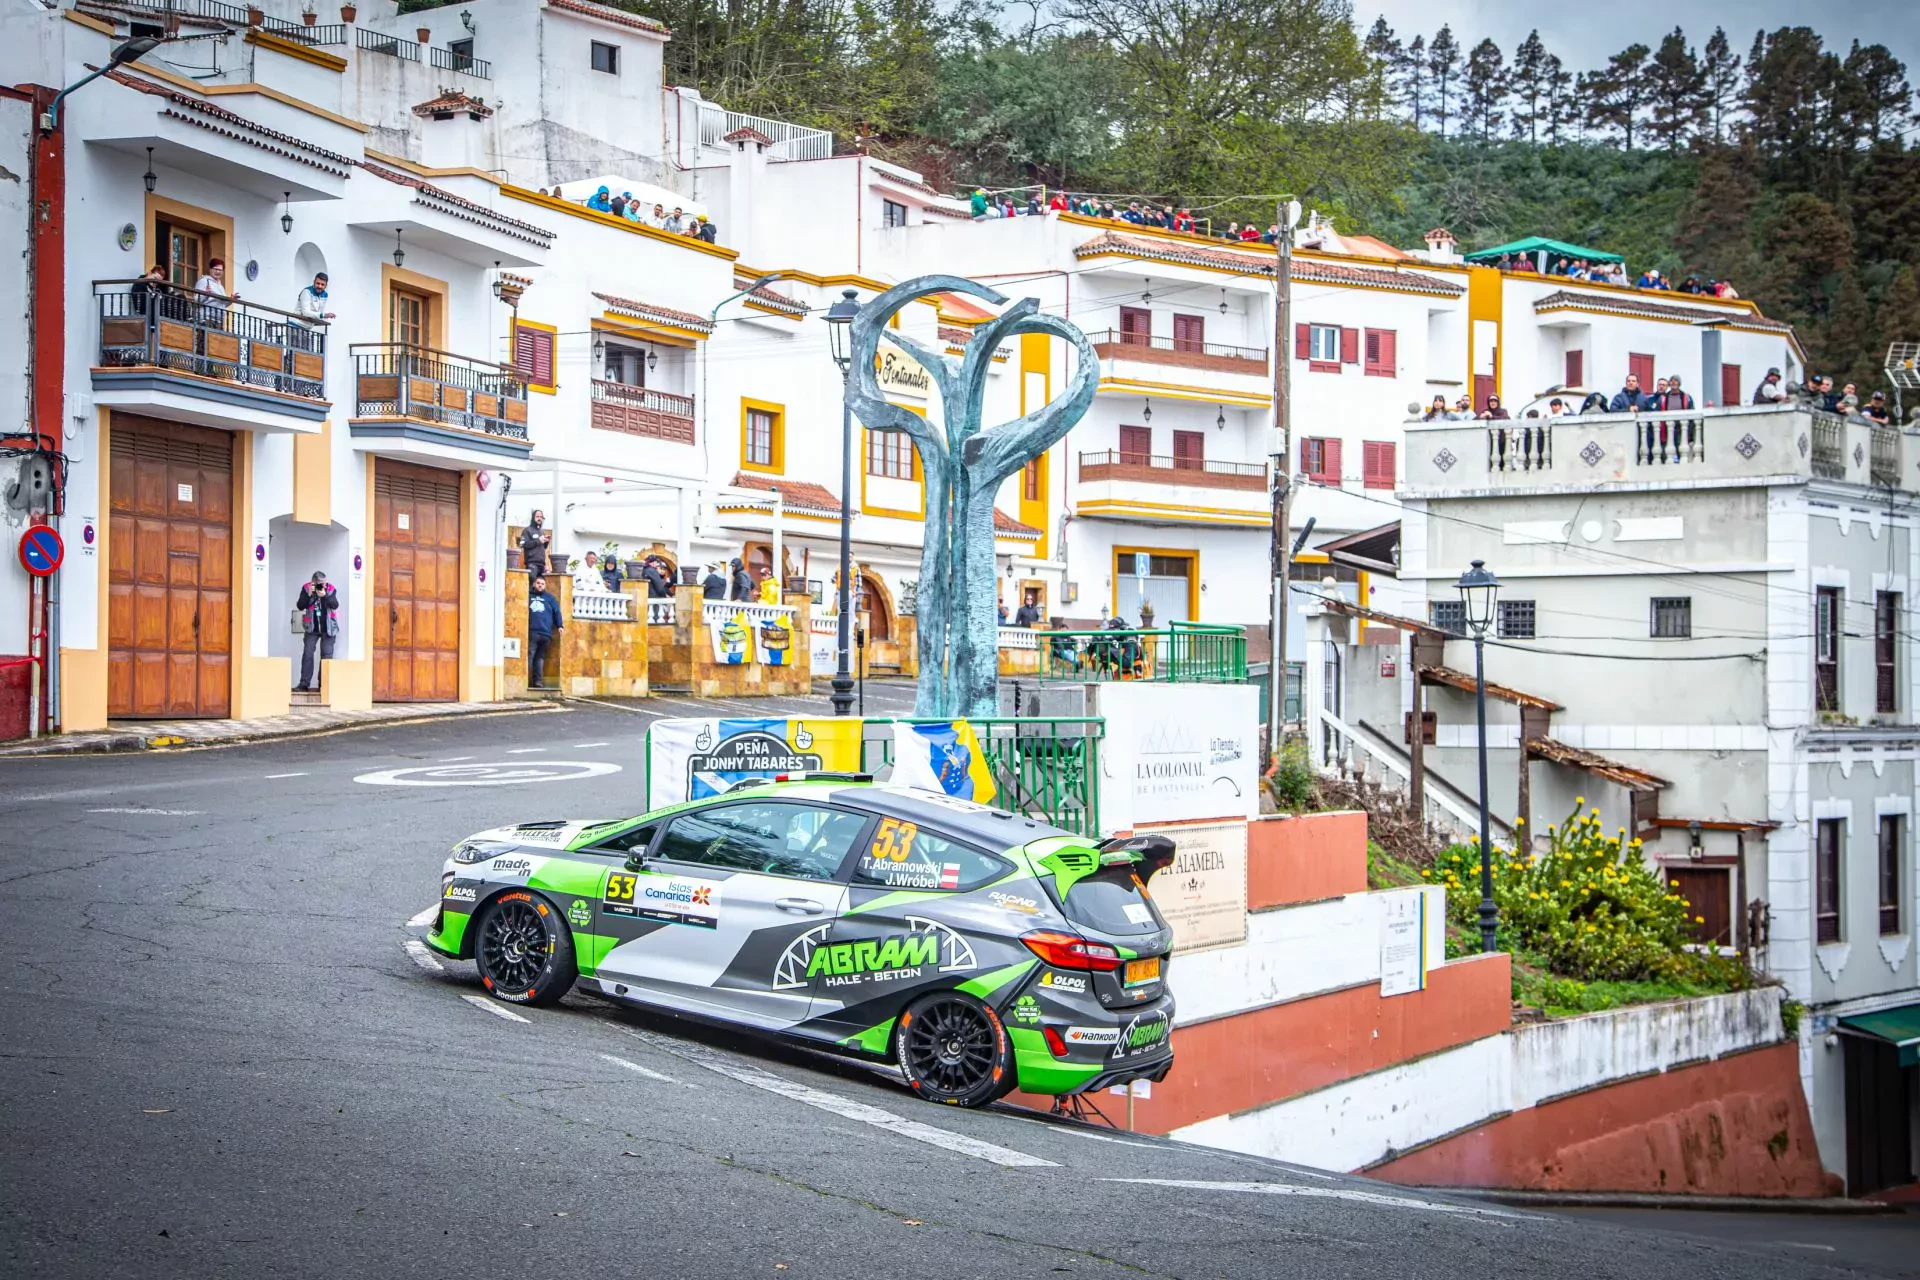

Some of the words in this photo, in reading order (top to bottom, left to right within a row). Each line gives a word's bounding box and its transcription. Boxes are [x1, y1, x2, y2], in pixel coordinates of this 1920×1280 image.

[882, 352, 929, 390] Fontanales
[735, 738, 769, 755] PEÑA
[703, 757, 744, 770] JONHY
[747, 756, 804, 770] TABARES
[1137, 763, 1151, 779] LA
[1153, 761, 1206, 778] COLONIAL
[872, 817, 918, 862] 53
[493, 859, 531, 869] made
[863, 857, 942, 874] T.Abramowski
[1176, 851, 1225, 874] ALAMEDA
[518, 868, 531, 877] in
[885, 872, 938, 888] J.Wróbel
[453, 887, 477, 898] OLPOL
[608, 875, 636, 899] 53
[645, 887, 691, 903] Canarias
[669, 881, 693, 894] Islas
[806, 933, 940, 978] ABRAM
[826, 975, 861, 987] HALE
[874, 968, 922, 982] BETON
[1053, 975, 1086, 989] OLPOL
[1127, 1020, 1165, 1048] ABRAM
